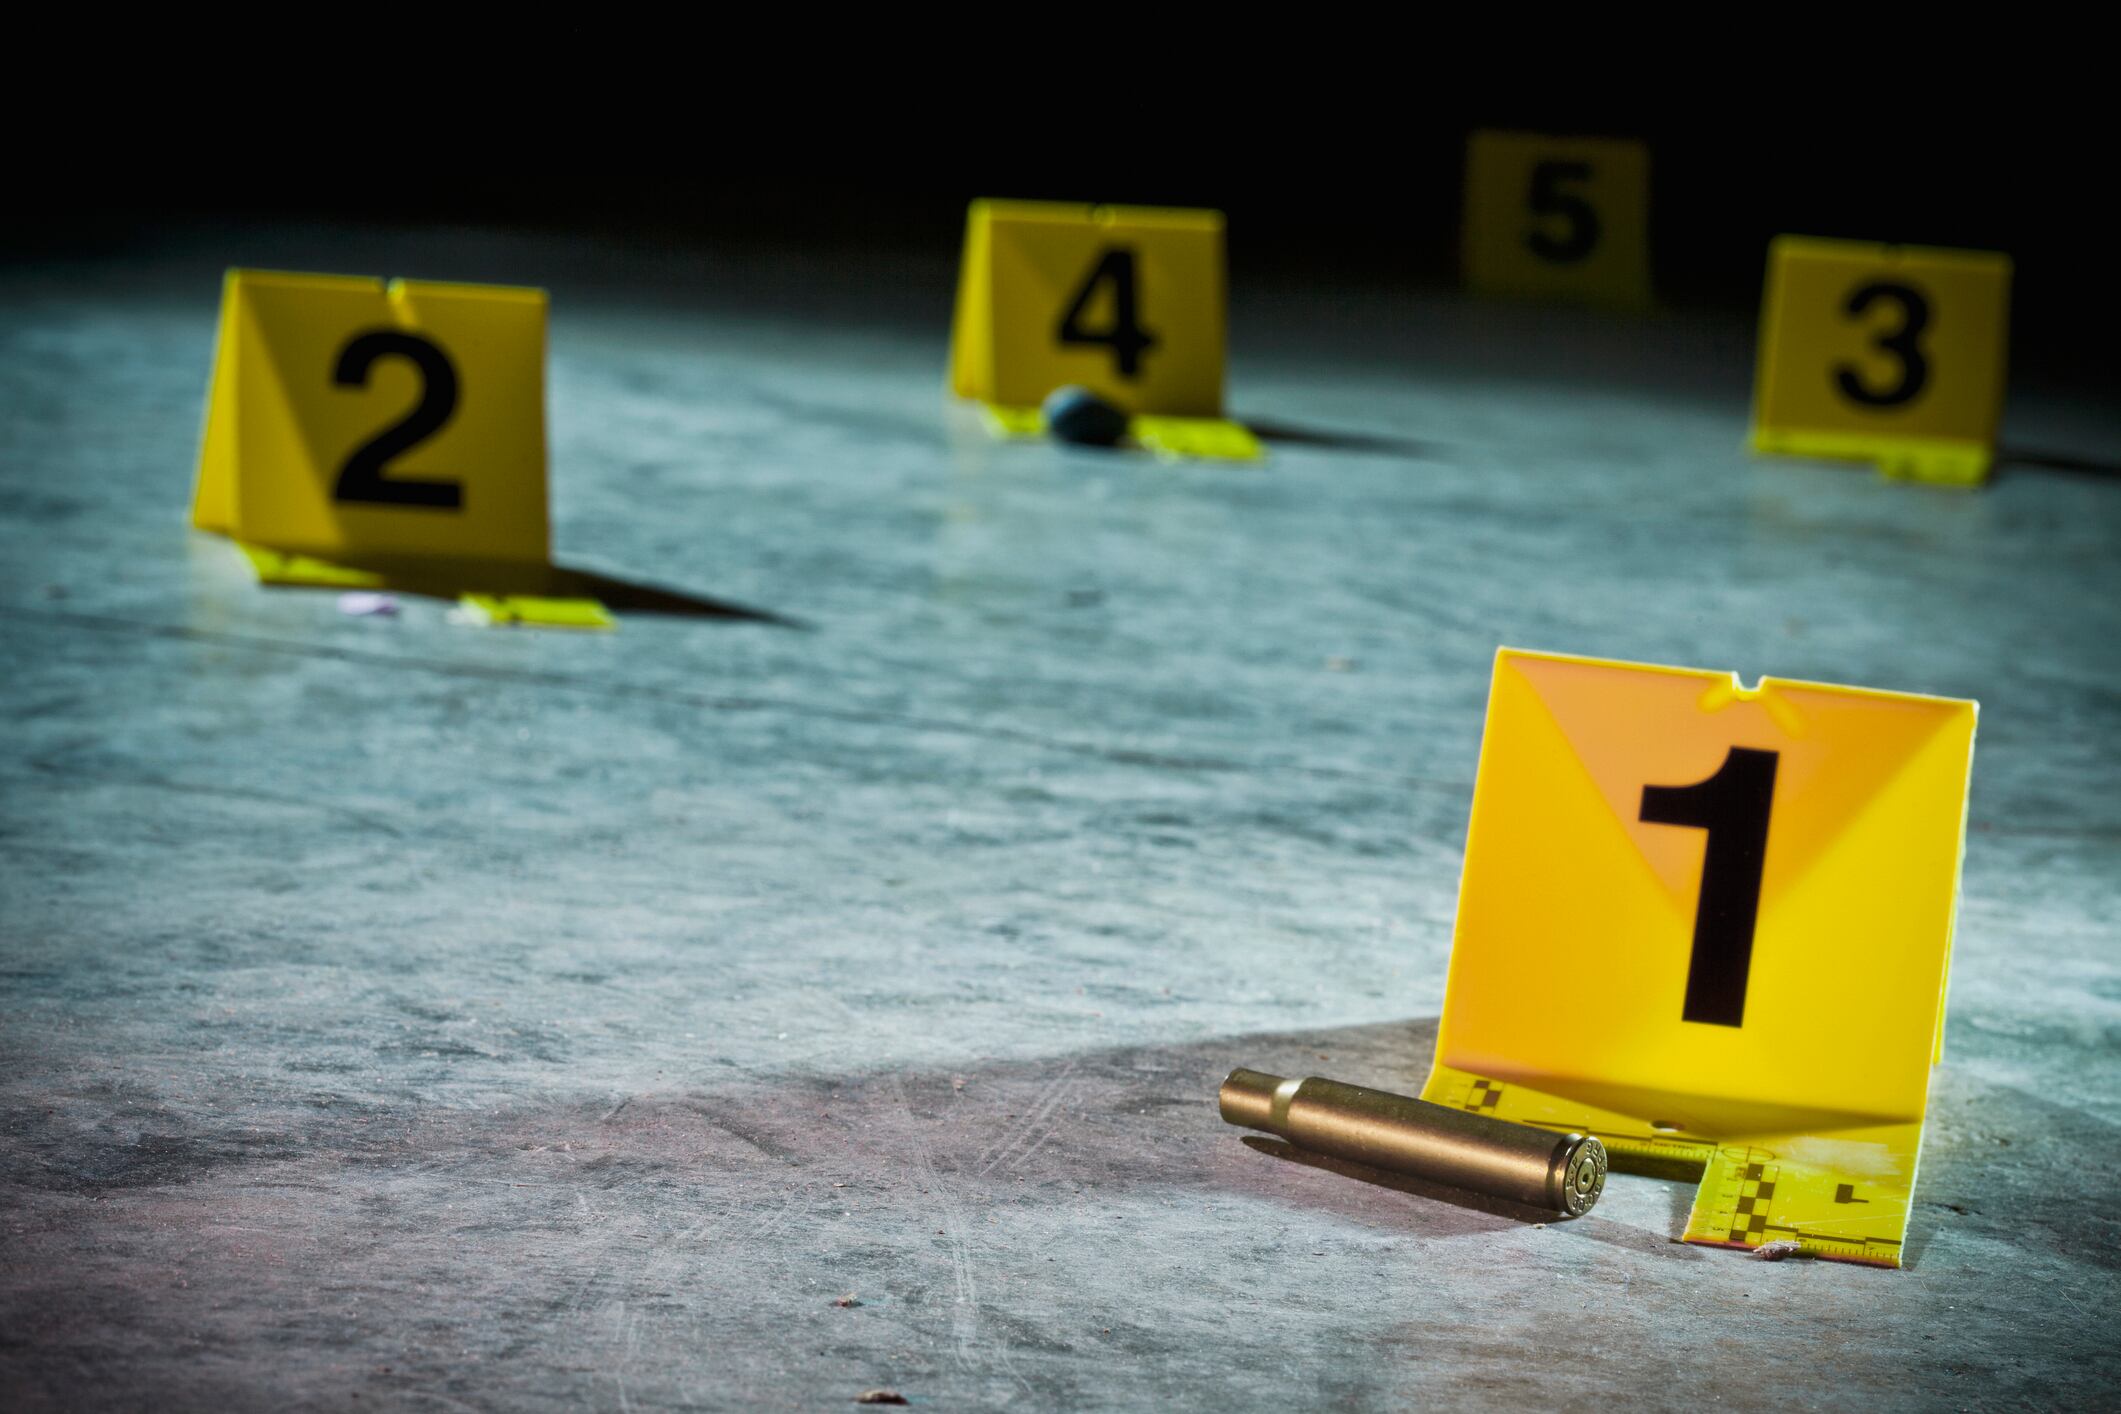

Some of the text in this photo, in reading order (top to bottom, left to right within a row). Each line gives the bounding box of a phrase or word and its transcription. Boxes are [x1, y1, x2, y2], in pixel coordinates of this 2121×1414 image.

[1526, 158, 1602, 266] 5
[1057, 247, 1157, 380] 4
[1834, 278, 1933, 409] 3
[332, 327, 464, 512] 2
[1640, 747, 1778, 1027] 1
